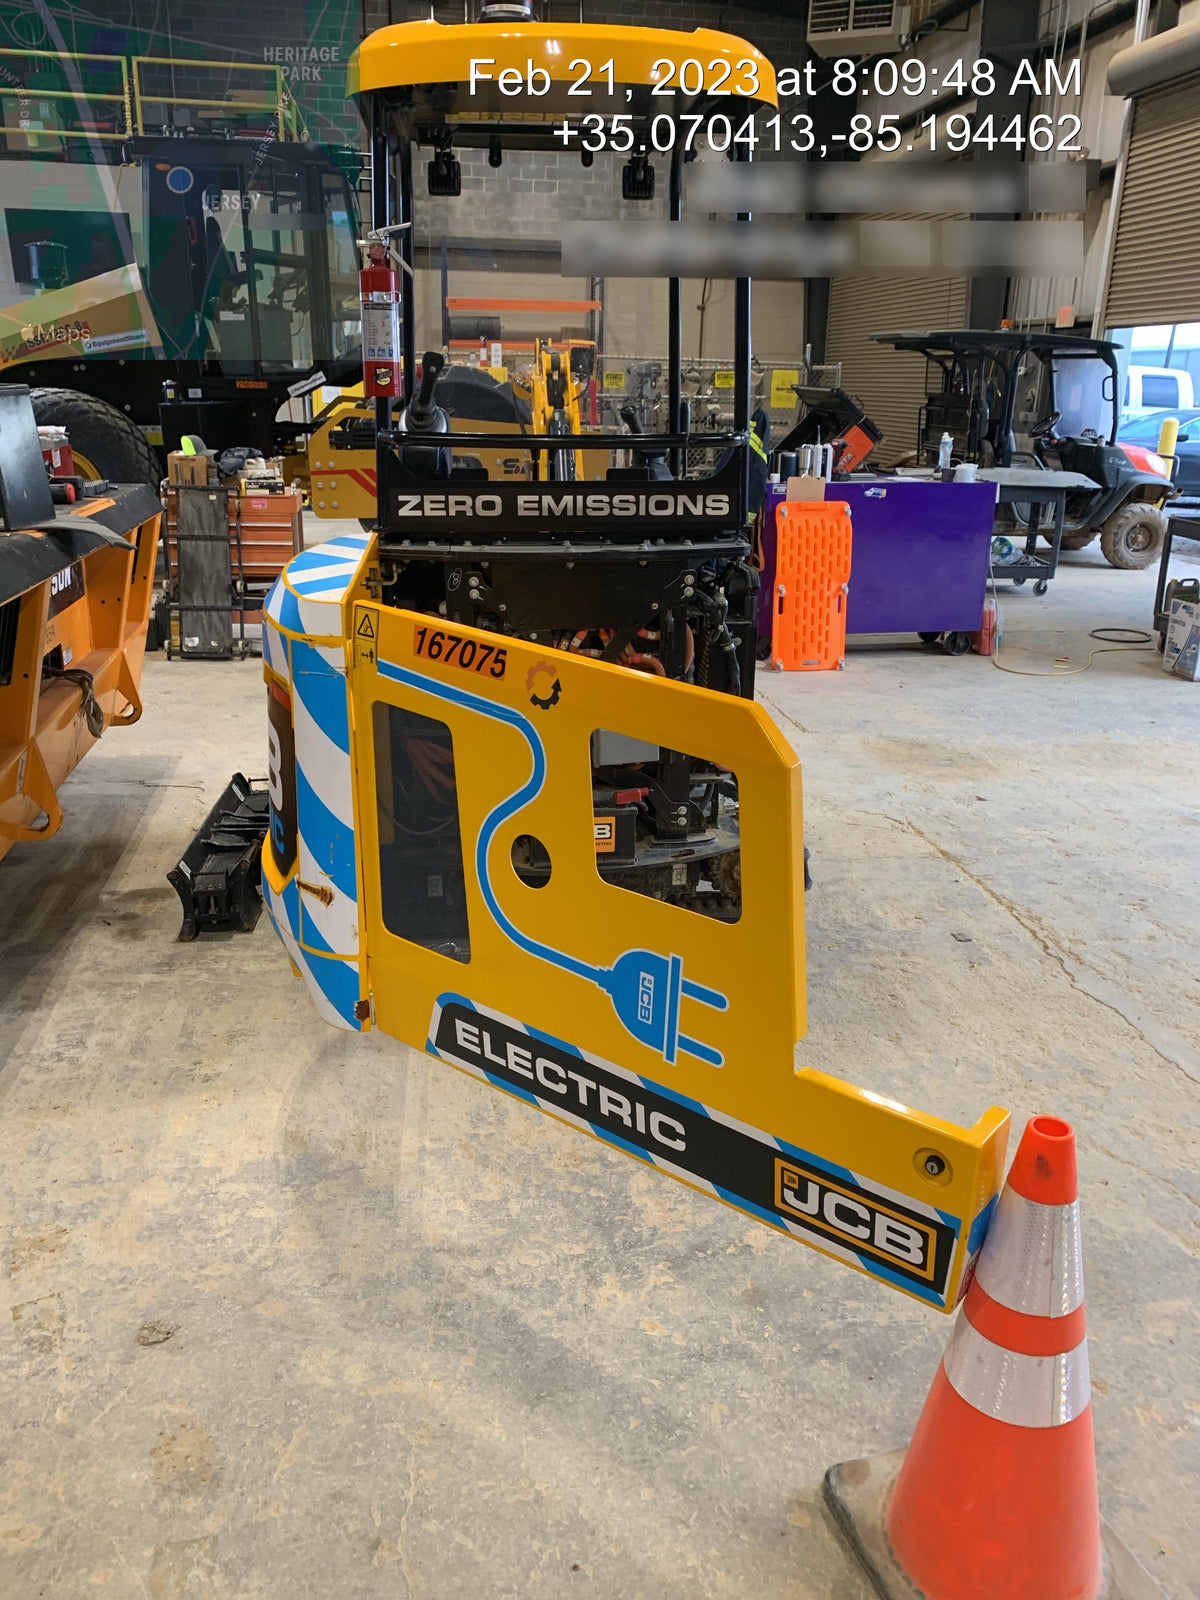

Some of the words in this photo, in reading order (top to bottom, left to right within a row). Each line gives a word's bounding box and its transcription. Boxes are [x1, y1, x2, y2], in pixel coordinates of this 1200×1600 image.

[397, 494, 503, 517] ZERO
[516, 494, 731, 517] EMISSIONS
[415, 627, 508, 678] 167075
[640, 976, 653, 1021] JCB
[454, 1017, 688, 1153] ELECTRIC
[783, 1179, 924, 1265] JCB
